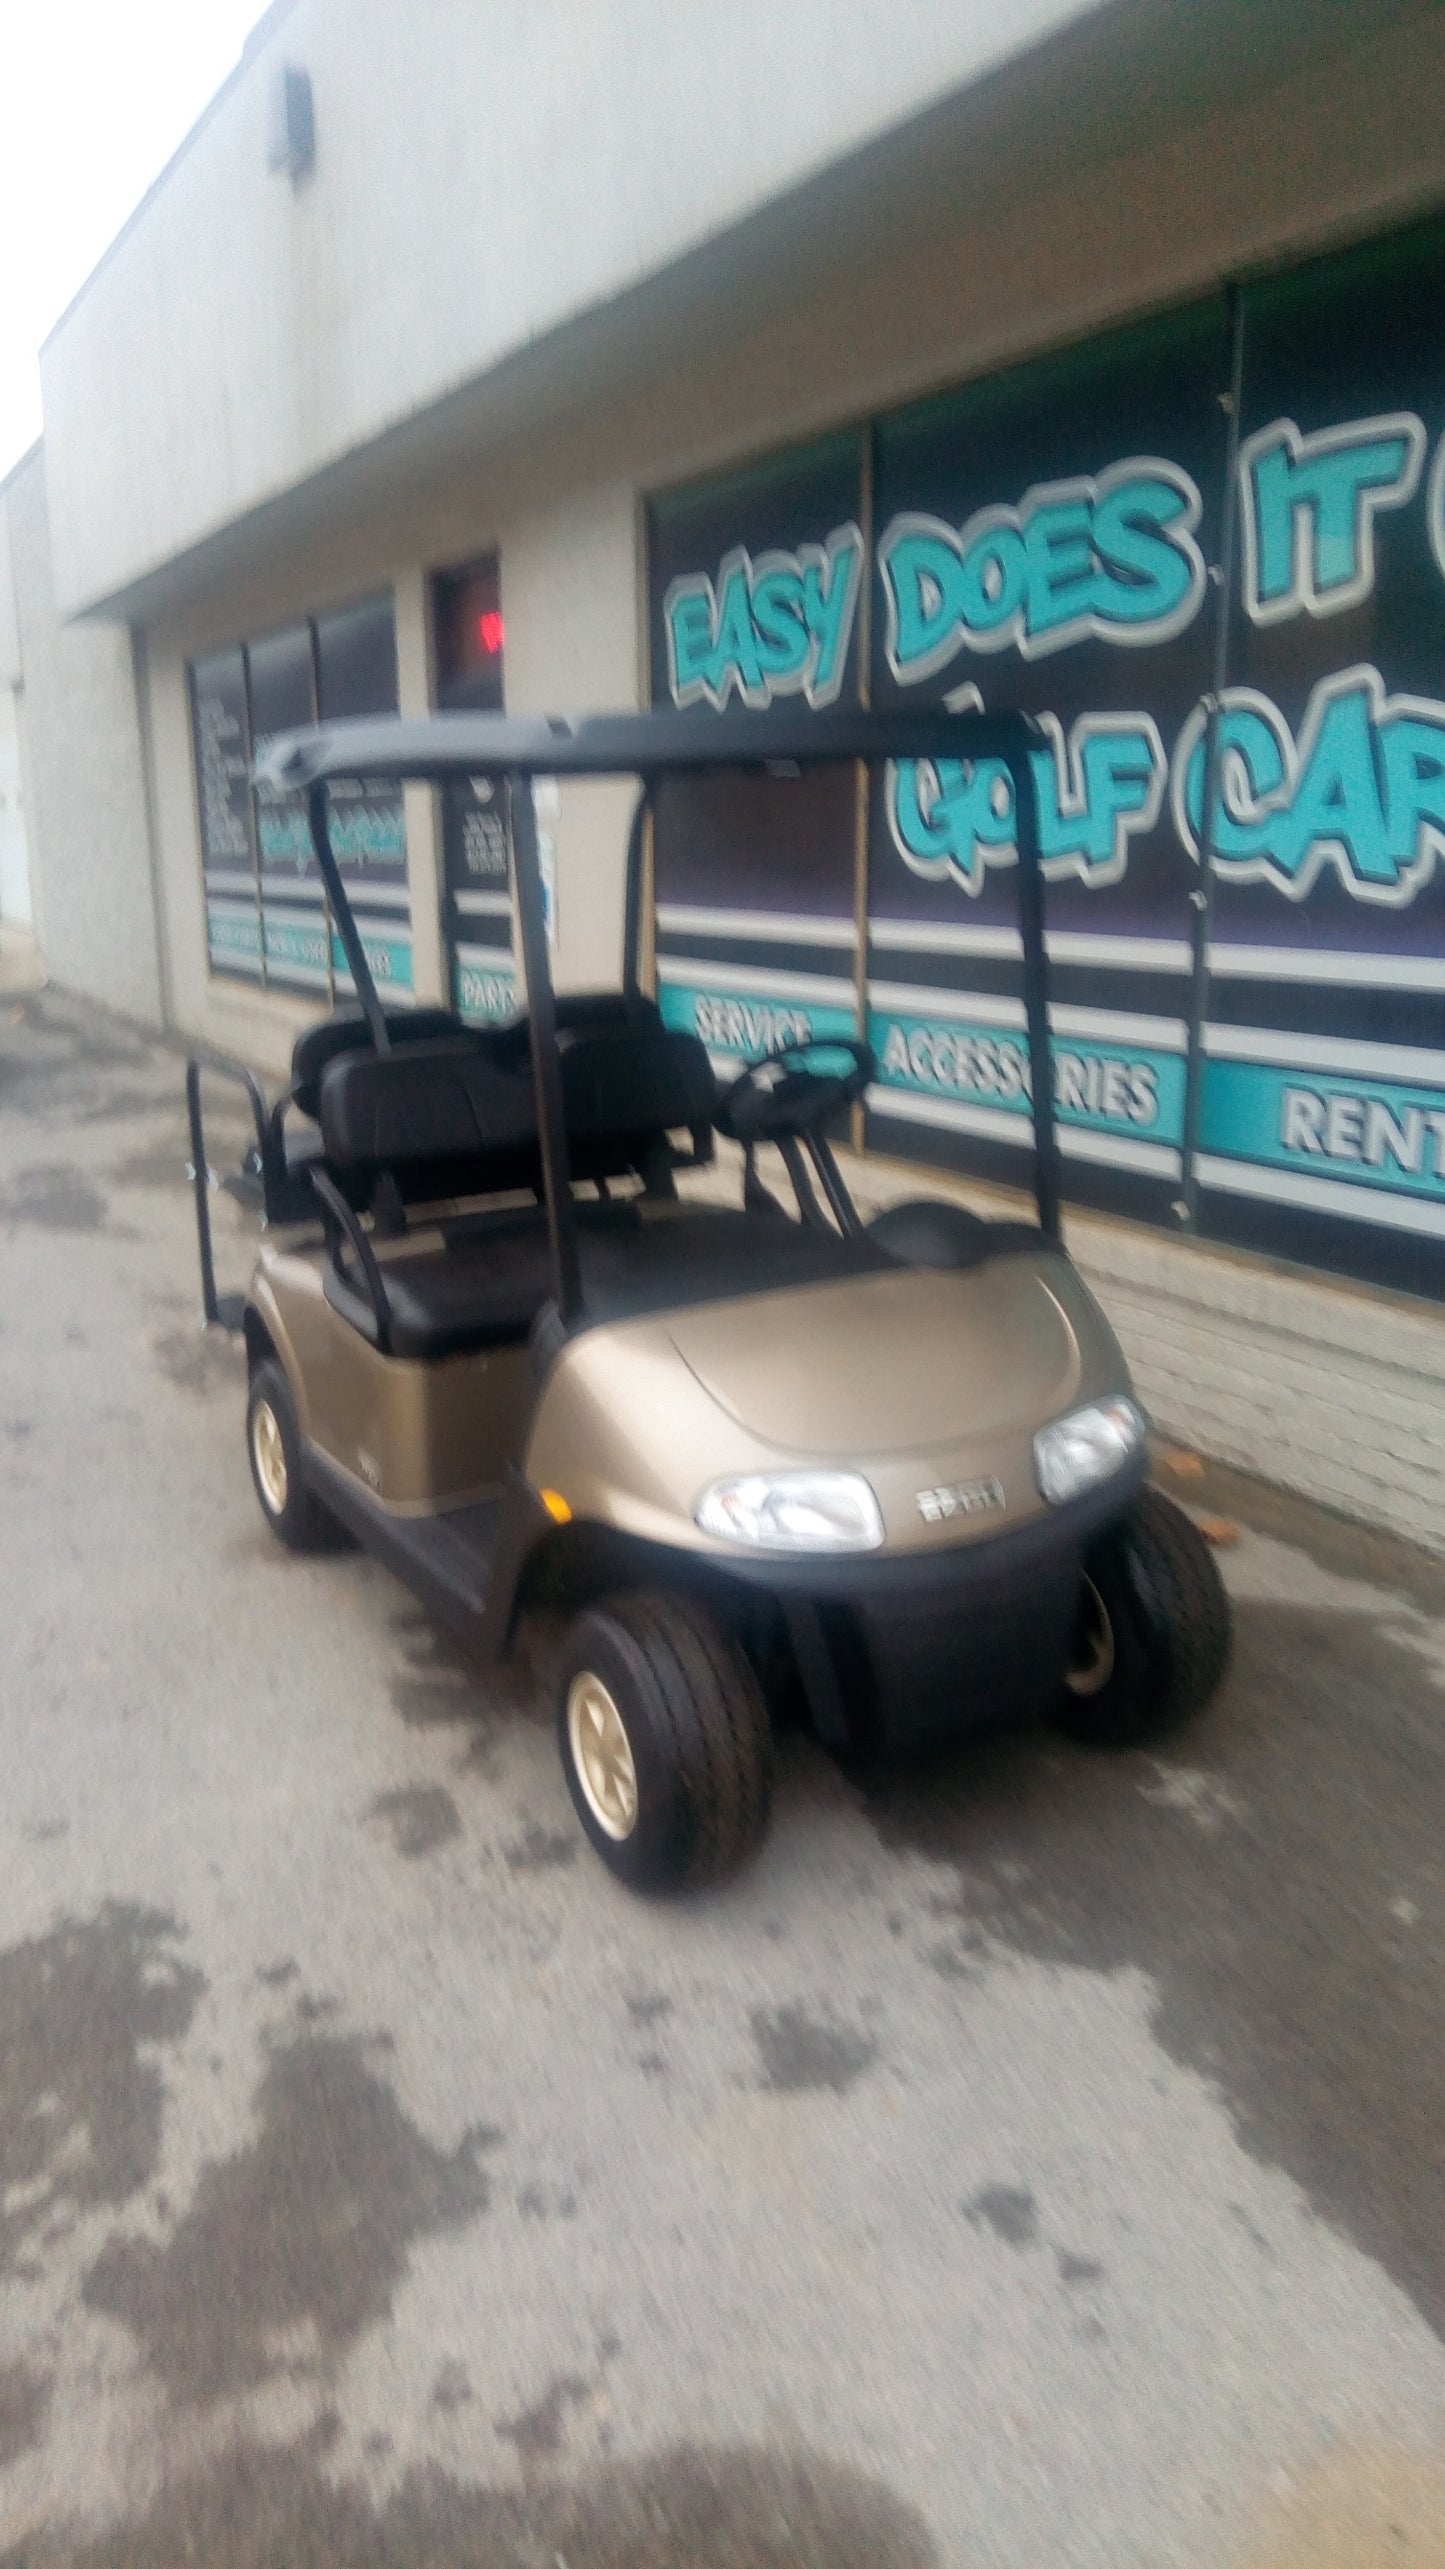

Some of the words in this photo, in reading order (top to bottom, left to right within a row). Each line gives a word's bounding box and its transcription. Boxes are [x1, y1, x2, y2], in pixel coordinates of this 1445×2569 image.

[666, 530, 866, 708] EASY
[882, 460, 1202, 682] DOES
[1242, 415, 1424, 624] IT
[887, 695, 1165, 893] GOLF
